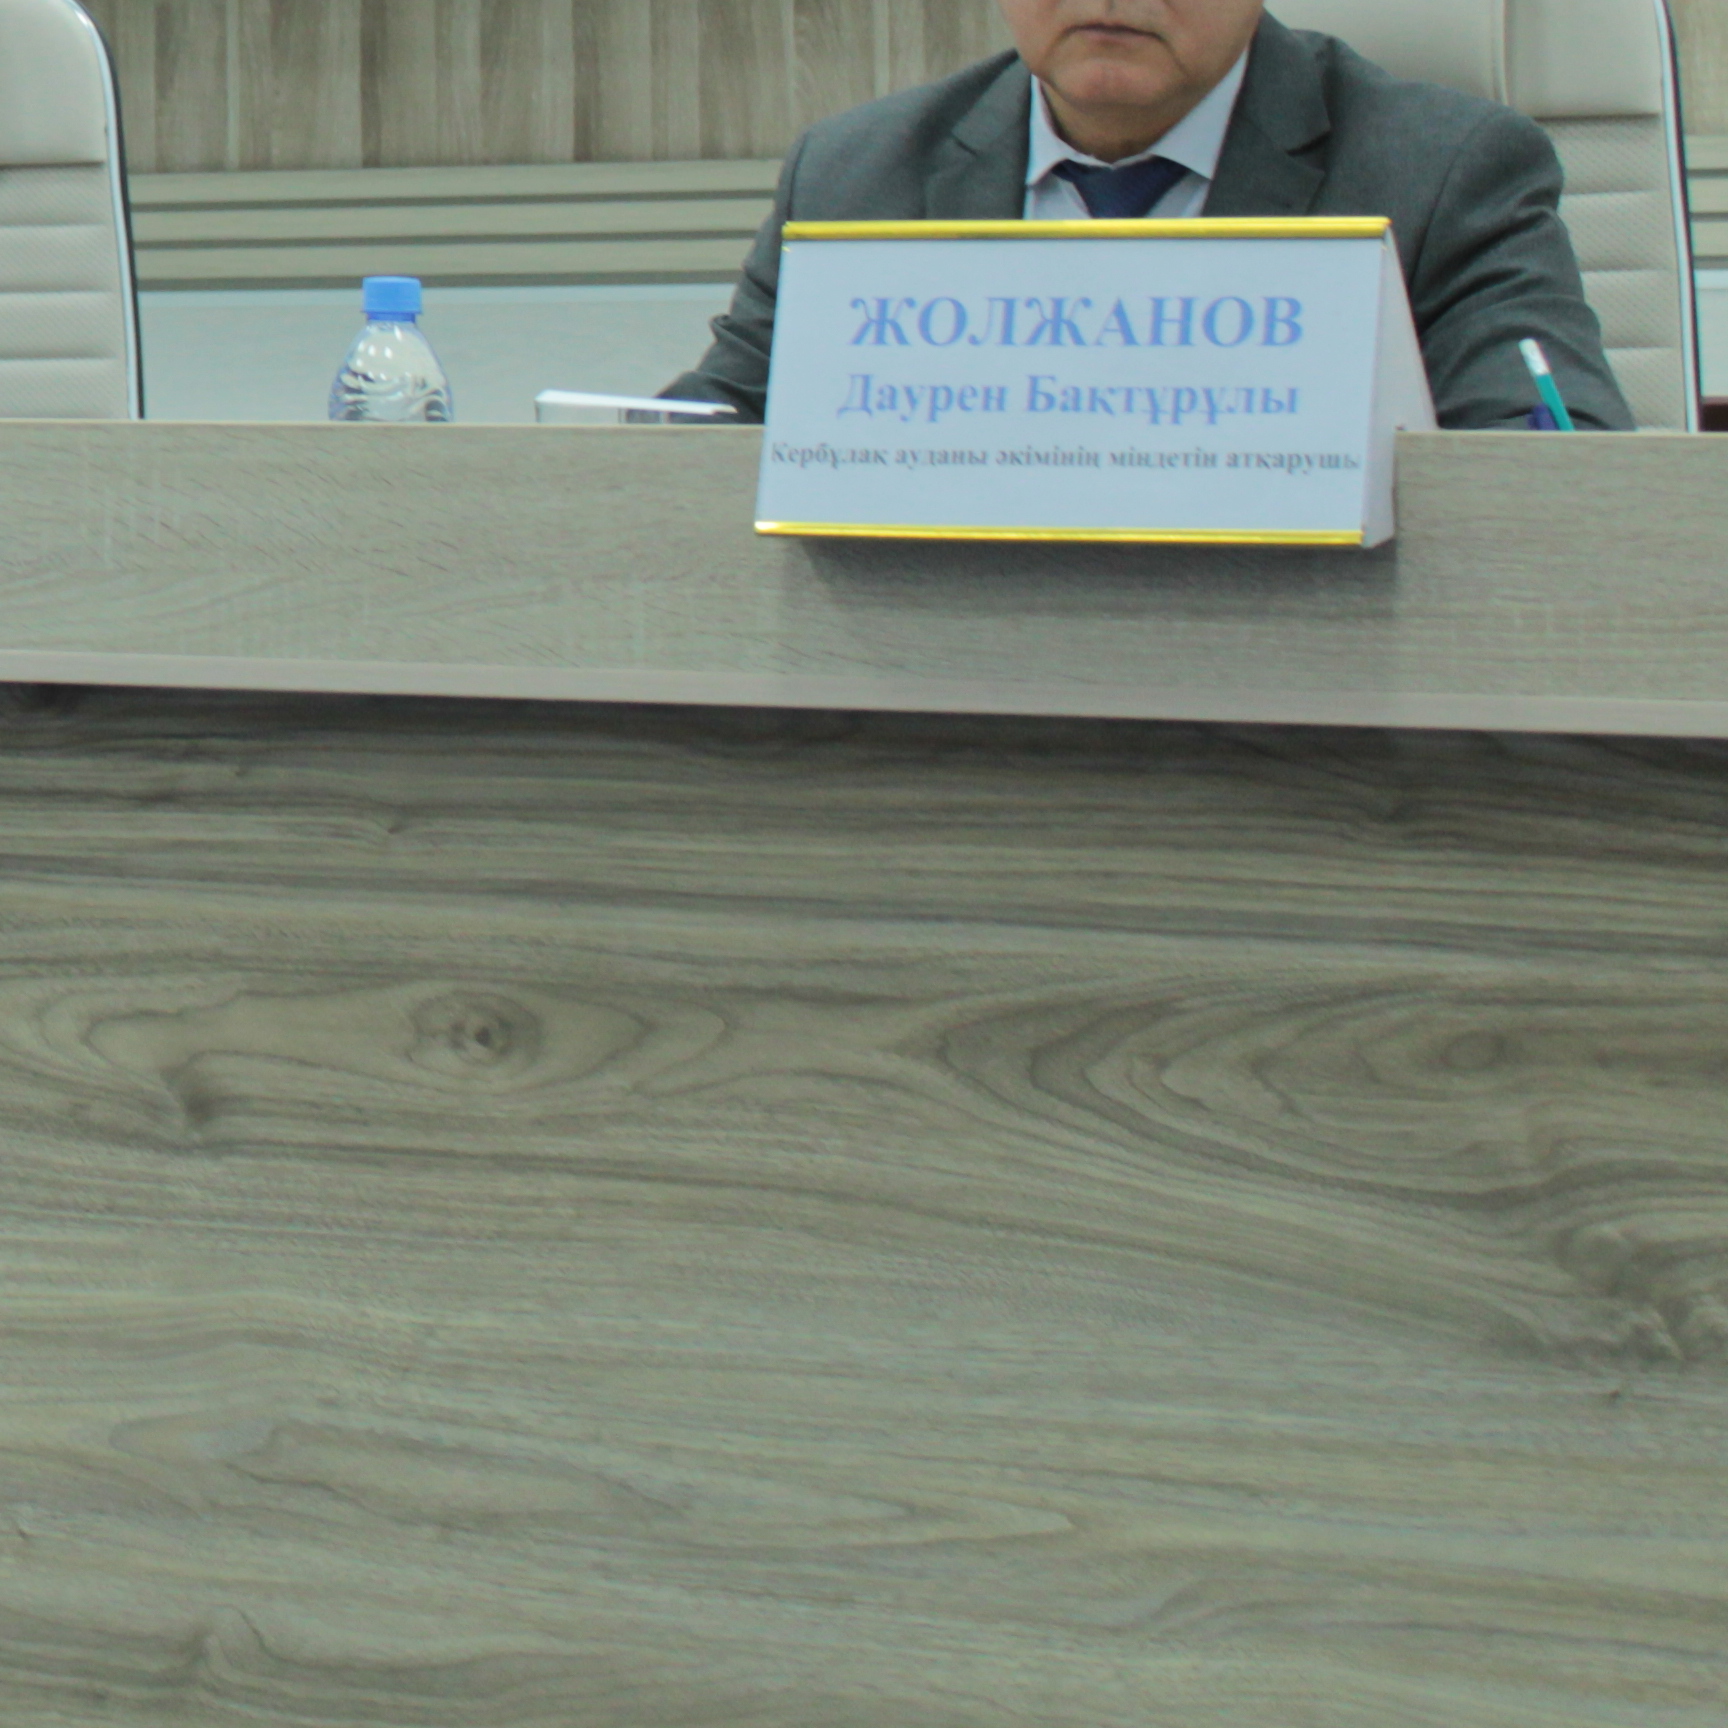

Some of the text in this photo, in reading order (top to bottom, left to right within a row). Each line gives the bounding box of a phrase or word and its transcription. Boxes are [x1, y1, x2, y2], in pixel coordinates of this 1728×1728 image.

[850, 296, 1303, 347] ЖОЛЖАНОВ
[836, 374, 1007, 421] Даурен
[895, 448, 988, 470] ауданы
